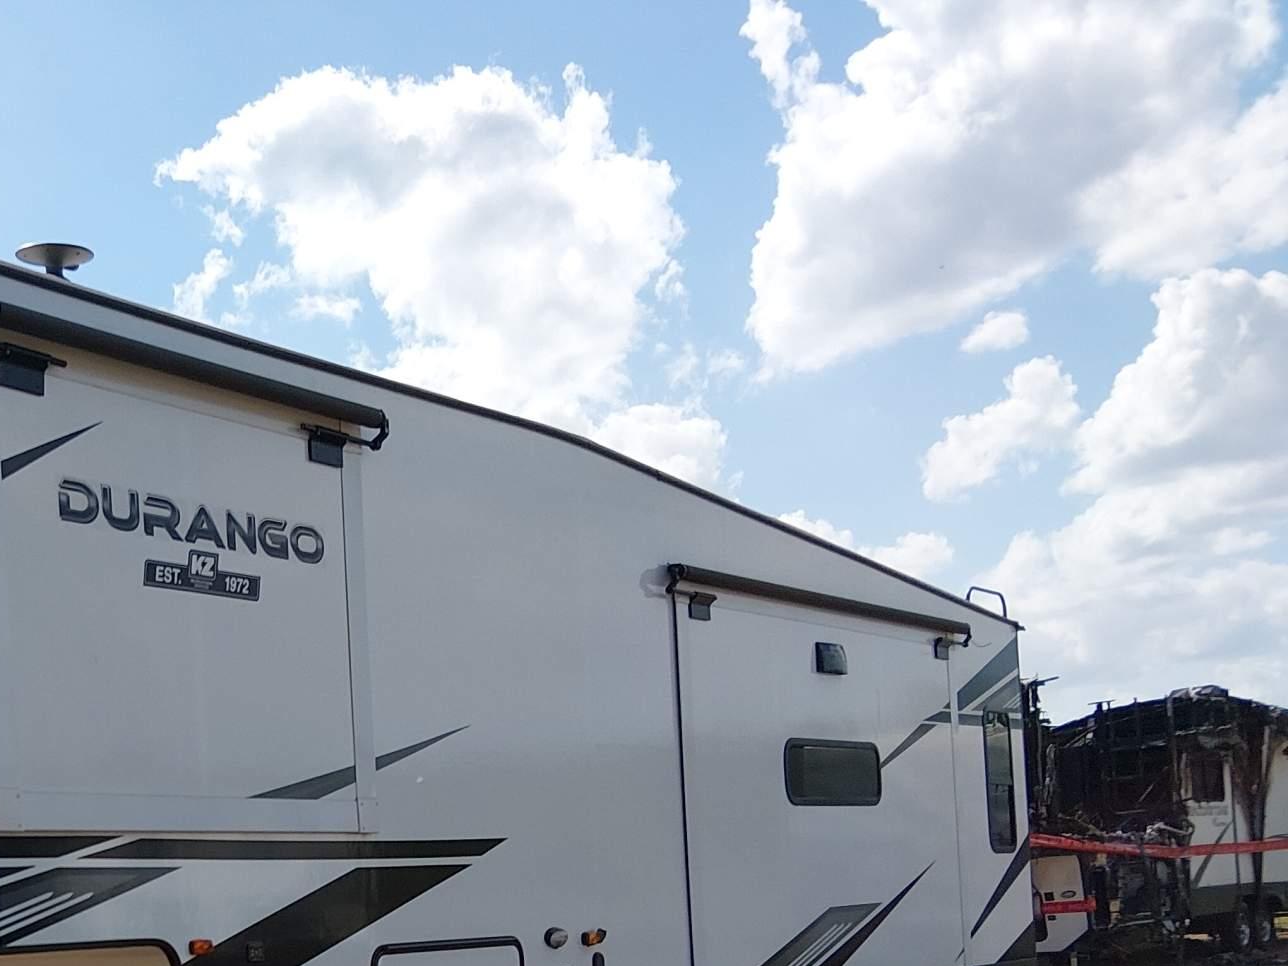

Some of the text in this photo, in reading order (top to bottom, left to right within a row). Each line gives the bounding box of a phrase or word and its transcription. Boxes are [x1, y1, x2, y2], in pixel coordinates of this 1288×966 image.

[58, 479, 325, 565] DURANGO
[155, 565, 182, 585] EST.
[224, 576, 250, 594] 1972
[191, 554, 215, 577] KZ
